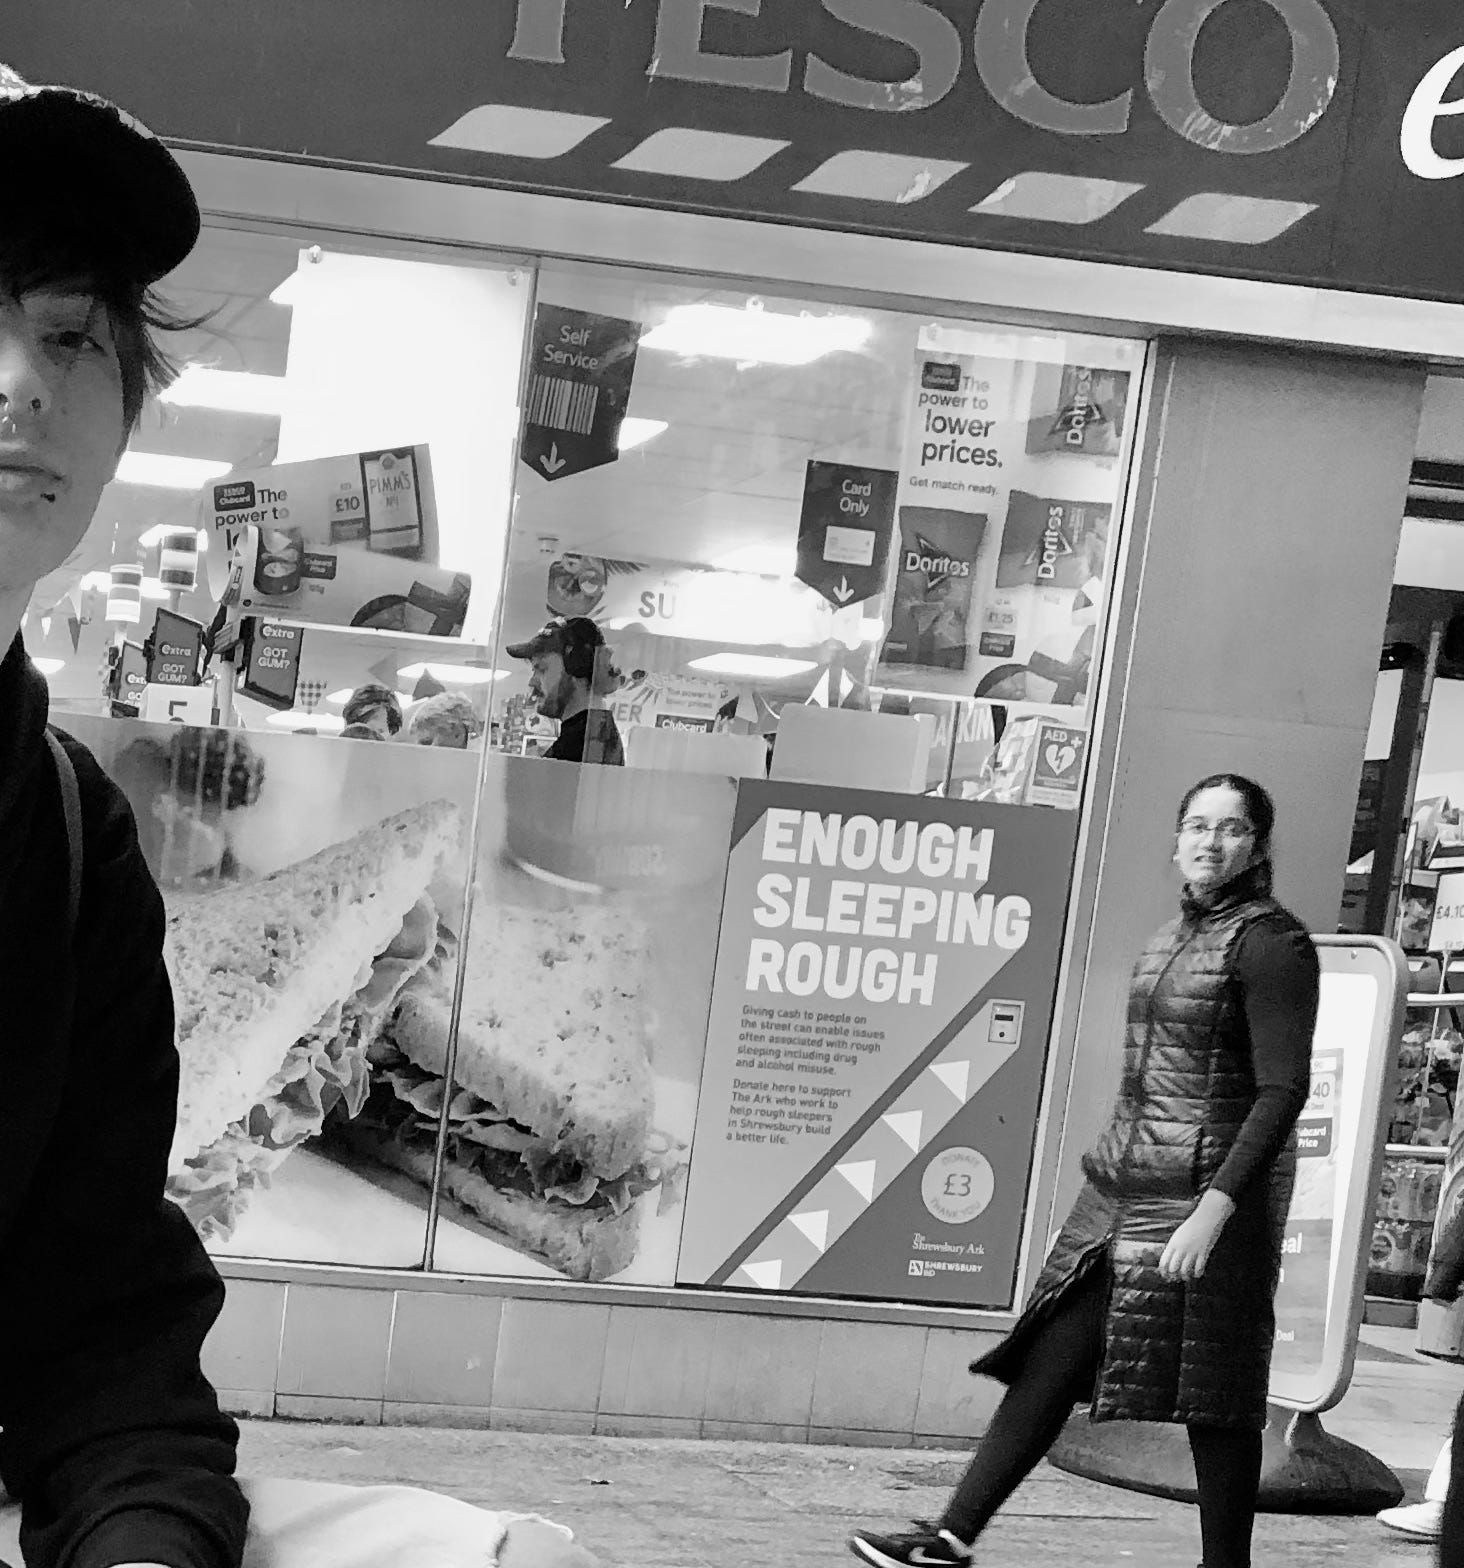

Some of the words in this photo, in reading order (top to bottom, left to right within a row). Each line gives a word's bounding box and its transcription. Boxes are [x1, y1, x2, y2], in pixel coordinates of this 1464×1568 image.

[559, 324, 592, 346] Self
[543, 343, 599, 370] Service
[962, 376, 990, 393] The
[918, 391, 969, 409] power
[972, 395, 989, 411] to
[924, 408, 997, 438] lower
[920, 438, 1003, 469] prices.
[841, 478, 872, 497] Card
[909, 475, 930, 488] Get
[931, 477, 965, 492] match
[257, 488, 289, 504] The
[335, 495, 361, 514] £10
[839, 496, 871, 518] Only
[215, 509, 269, 530] power
[271, 506, 291, 521] to
[1037, 505, 1064, 579] Doritos
[905, 551, 970, 578] Doritos
[262, 645, 289, 658] GOT
[162, 662, 185, 674] GOT
[257, 656, 291, 670] GUM?
[610, 702, 643, 723] ER
[662, 718, 708, 734] Clubcard
[1043, 729, 1068, 743] AED
[761, 807, 996, 882] ENOUGH
[752, 872, 1033, 950] SLEEPING
[744, 937, 940, 1006] ROUGH
[742, 1004, 775, 1019] Giving
[777, 1008, 801, 1019] cash
[804, 1010, 814, 1021] to
[816, 1012, 852, 1025] people
[854, 1015, 867, 1025] on
[740, 1018, 758, 1029] the
[760, 1020, 791, 1032] street
[793, 1023, 813, 1034] can
[814, 1024, 850, 1037] enable
[852, 1029, 886, 1040] issues
[738, 1031, 766, 1042] often
[768, 1035, 824, 1047] associated
[825, 1038, 849, 1049] with
[850, 1041, 881, 1054] rough
[737, 1045, 782, 1059] sleeping
[783, 1048, 831, 1064] including
[833, 1051, 858, 1066] drug
[735, 1058, 755, 1069] and
[757, 1059, 795, 1072] alcohol
[797, 1063, 837, 1075] misuse.
[732, 1078, 770, 1091] Donate
[771, 1081, 796, 1093] here
[798, 1083, 809, 1094] to
[810, 1086, 852, 1098] support
[732, 1091, 751, 1102] The
[752, 1093, 772, 1104] Ark
[775, 1094, 797, 1106] who
[799, 1097, 826, 1109] work
[828, 1099, 839, 1110] to
[729, 1105, 753, 1118] help
[754, 1107, 786, 1121] rough
[787, 1110, 833, 1123] sleepers
[727, 1118, 738, 1128] in
[739, 1118, 803, 1136] Shrewsbury
[805, 1123, 832, 1135] build
[1297, 1126, 1327, 1137] ubcard
[726, 1132, 733, 1141] a
[735, 1131, 767, 1143] better
[769, 1133, 789, 1145] life.
[1297, 1137, 1319, 1148] Price
[943, 1173, 972, 1197] £3
[912, 1240, 966, 1255] Shrewsbury
[966, 1243, 985, 1255] Ark
[924, 1260, 983, 1273] SHREWSBURY
[1276, 1328, 1295, 1342] Deal
